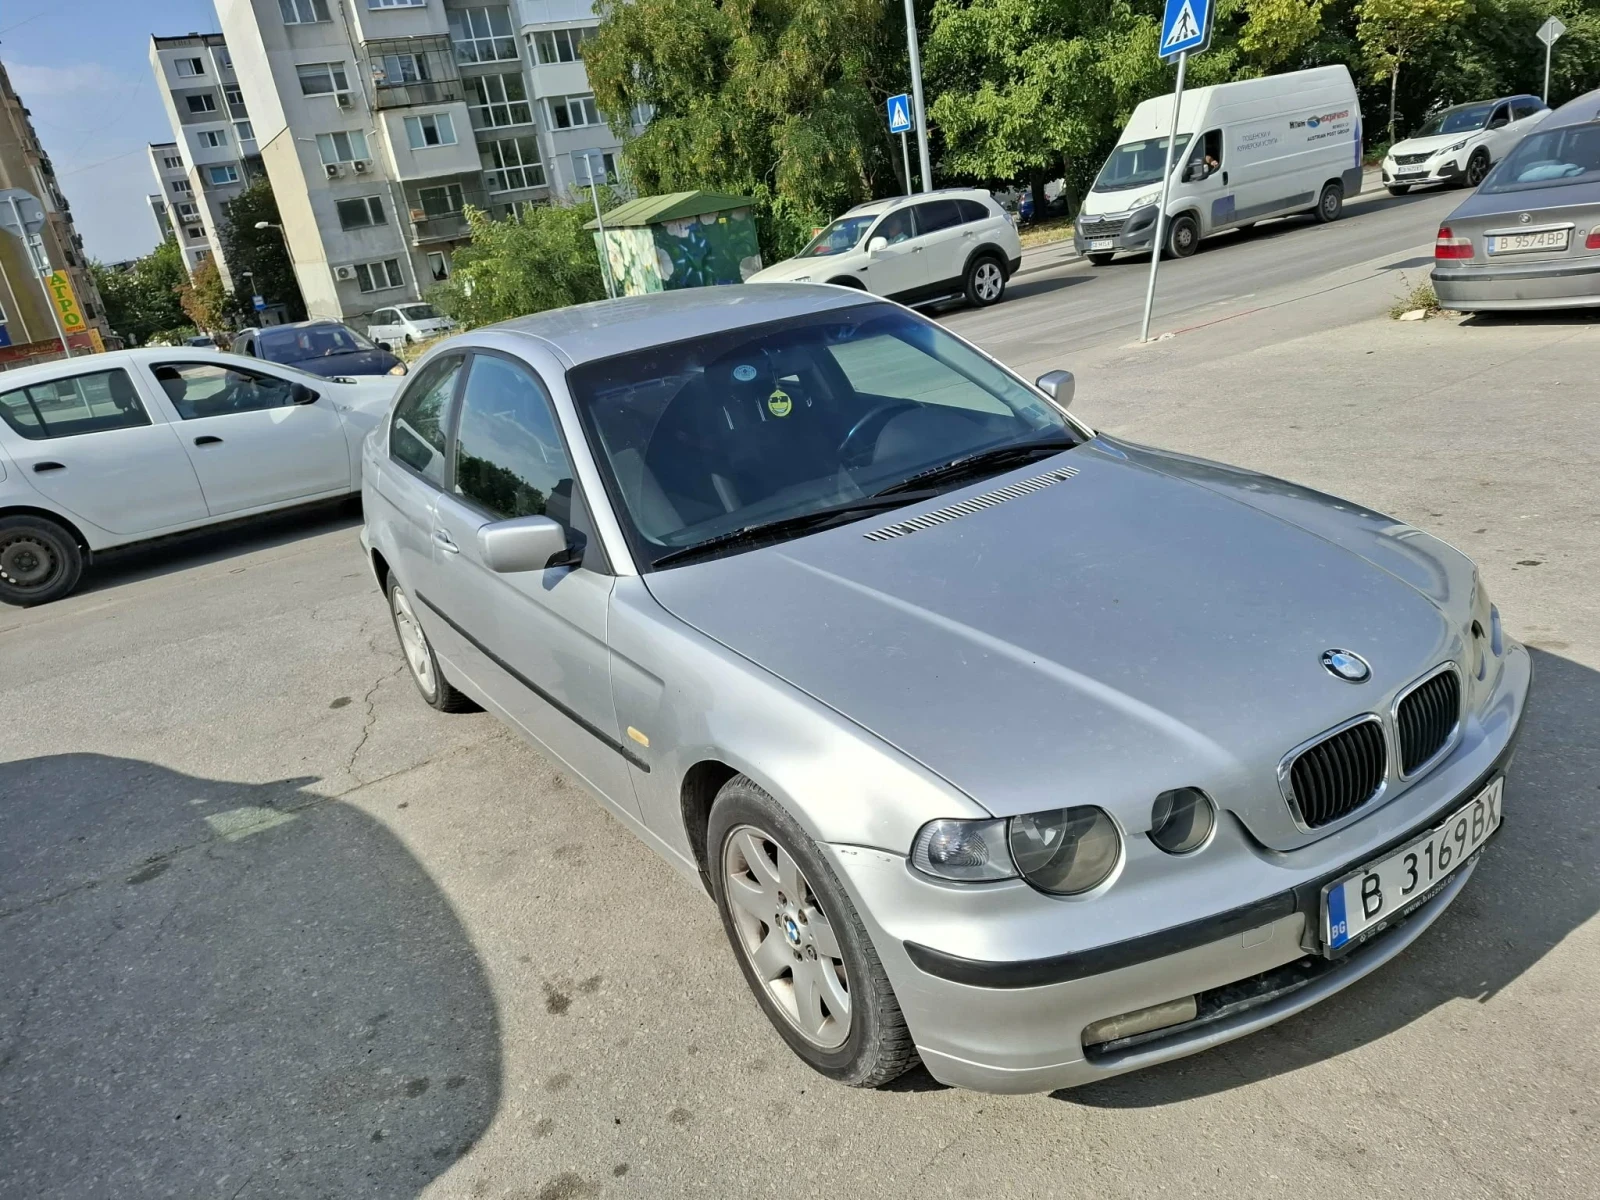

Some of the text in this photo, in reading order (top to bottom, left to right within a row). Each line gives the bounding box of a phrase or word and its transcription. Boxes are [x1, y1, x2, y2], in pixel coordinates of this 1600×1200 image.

[1320, 110, 1349, 123] express
[1307, 133, 1326, 141] AUSTRIAN
[50, 273, 80, 325] АГРО
[1361, 872, 1383, 920] B
[1332, 920, 1346, 939] BG
